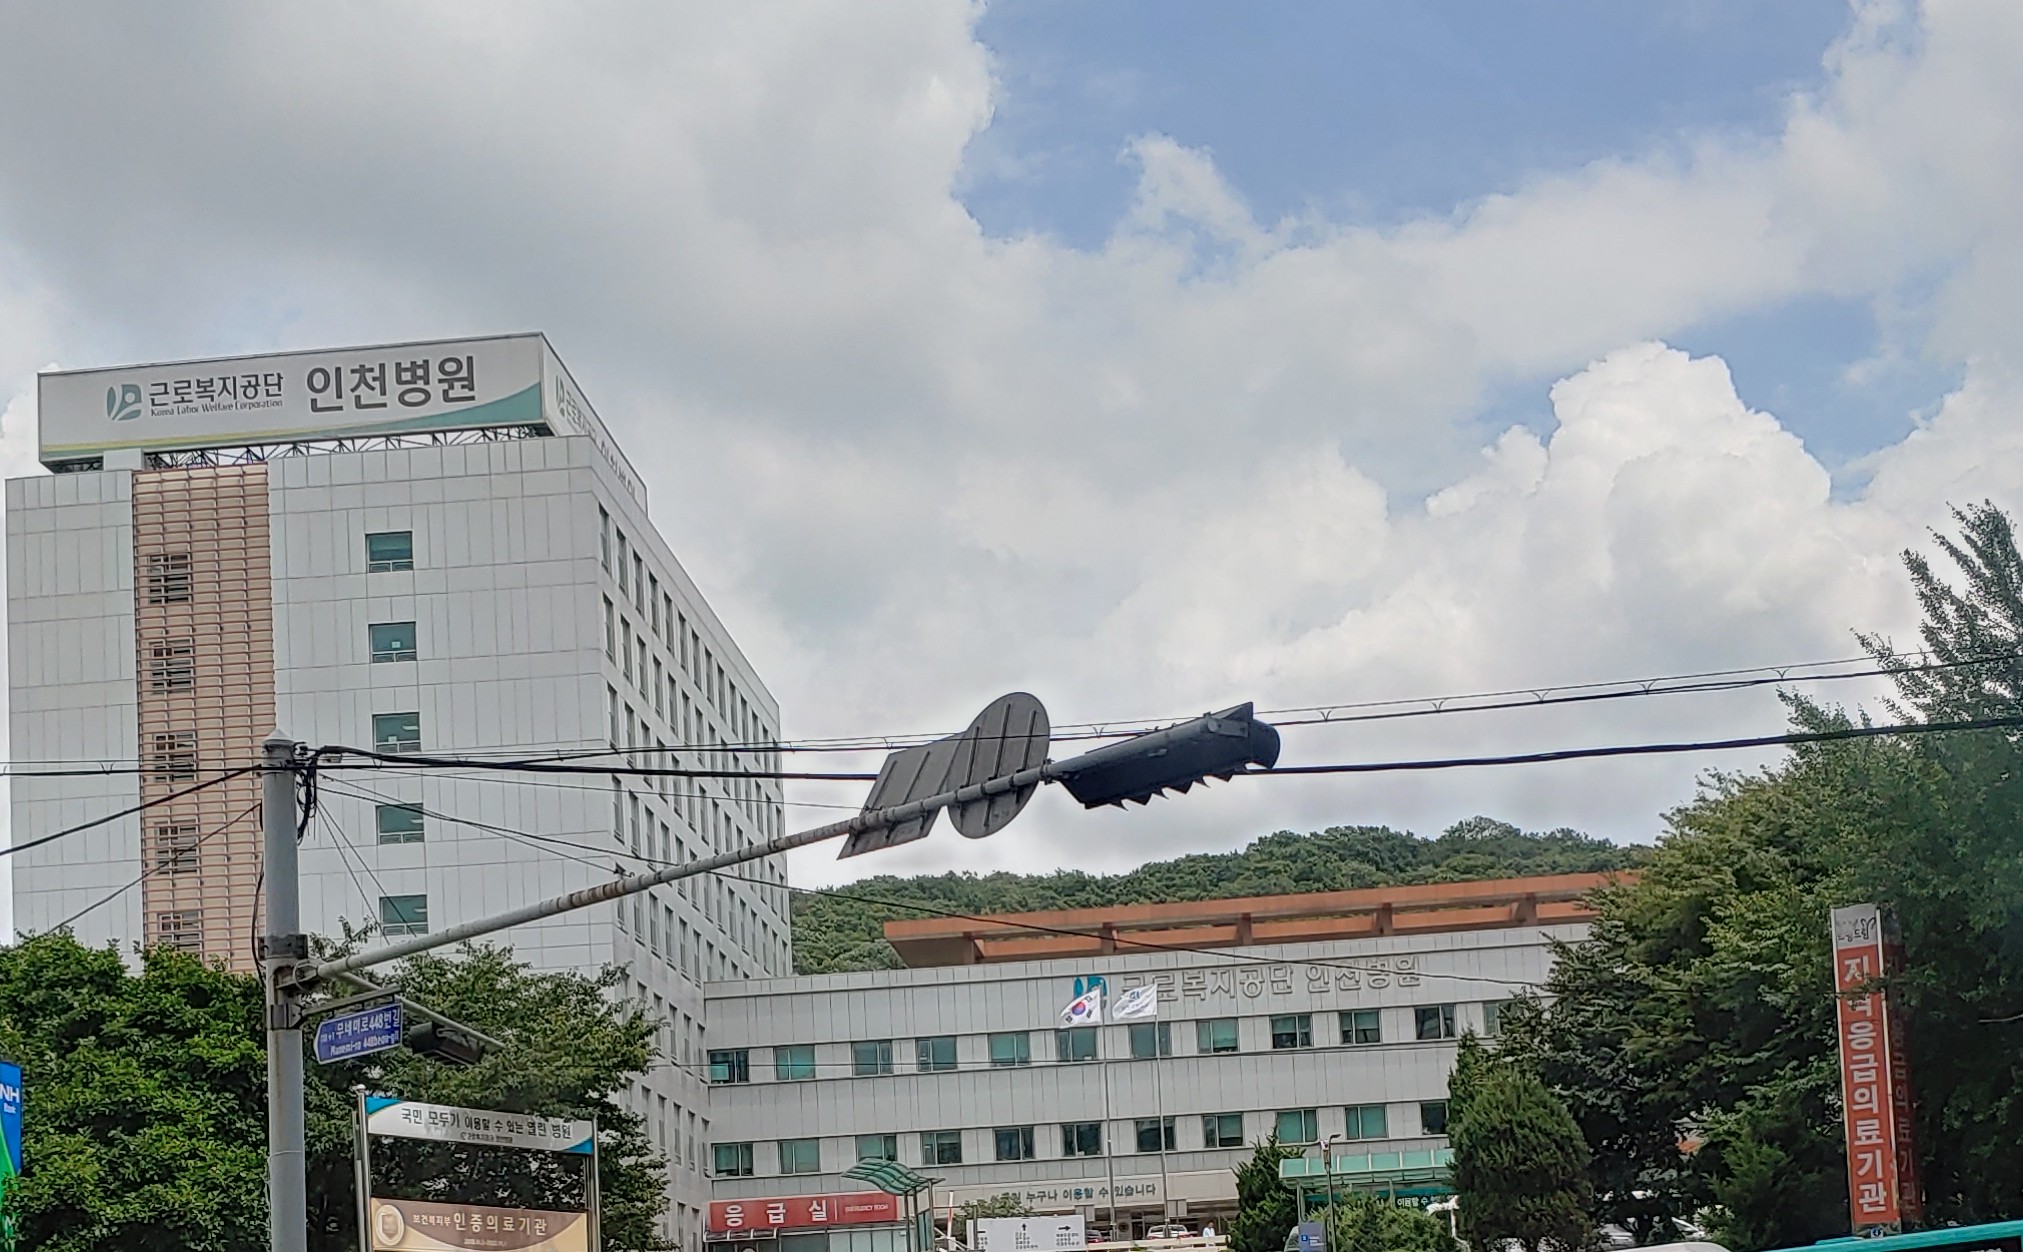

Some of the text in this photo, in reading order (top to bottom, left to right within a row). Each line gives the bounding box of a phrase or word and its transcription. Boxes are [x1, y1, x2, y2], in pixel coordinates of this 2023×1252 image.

[149, 355, 476, 413] 근로복지공단 인천병원
[151, 399, 283, 417] Korea Labor Welfare Corporation
[1305, 955, 1421, 994] 인천병원
[0, 1083, 20, 1103] NH
[401, 1108, 423, 1125] 국민
[464, 1115, 491, 1132] 이용할
[494, 1119, 504, 1133] 수
[506, 1120, 524, 1135] 있는
[551, 1123, 573, 1140] 병원
[1026, 1188, 1058, 1204] 누구나
[1062, 1186, 1094, 1201] 이용할
[1098, 1185, 1109, 1199] 수
[1114, 1182, 1157, 1198] 있습니다
[453, 1211, 548, 1236] 인증의료기관
[724, 1199, 829, 1228] 응급실
